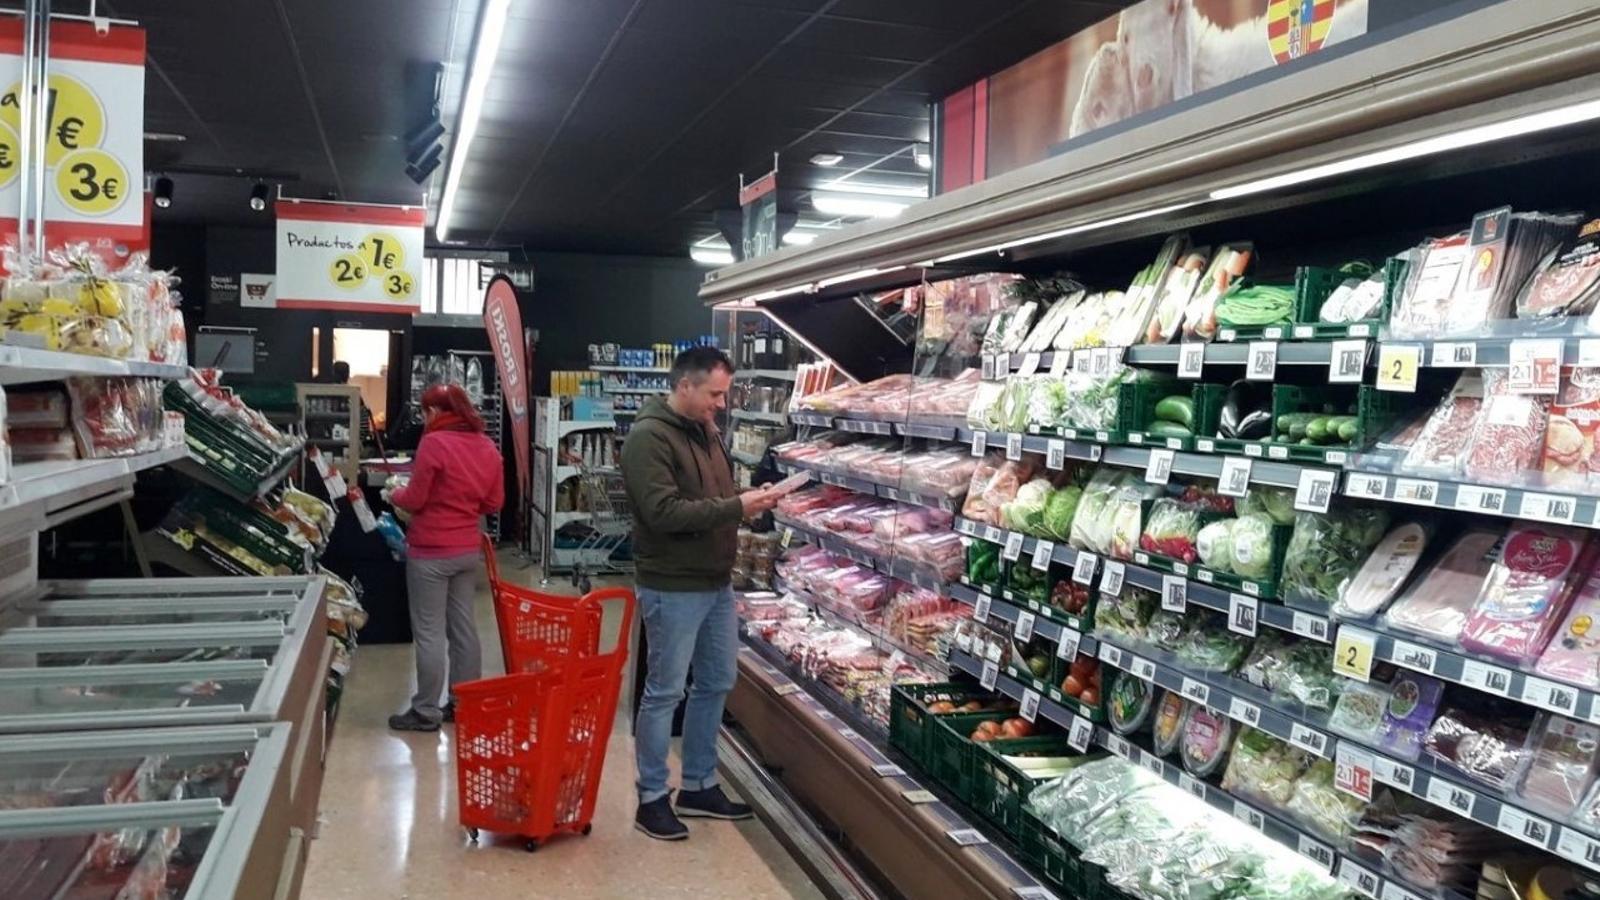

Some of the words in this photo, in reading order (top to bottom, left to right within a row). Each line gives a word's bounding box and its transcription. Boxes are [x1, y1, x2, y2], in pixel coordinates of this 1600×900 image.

[70, 162, 118, 202] 3€
[287, 232, 354, 248] Productos
[358, 242, 367, 251] a
[372, 238, 396, 270] 1€
[335, 258, 363, 282] 2€
[388, 274, 411, 294] 3€
[1392, 359, 1402, 380] 2
[1346, 646, 1357, 668] 2
